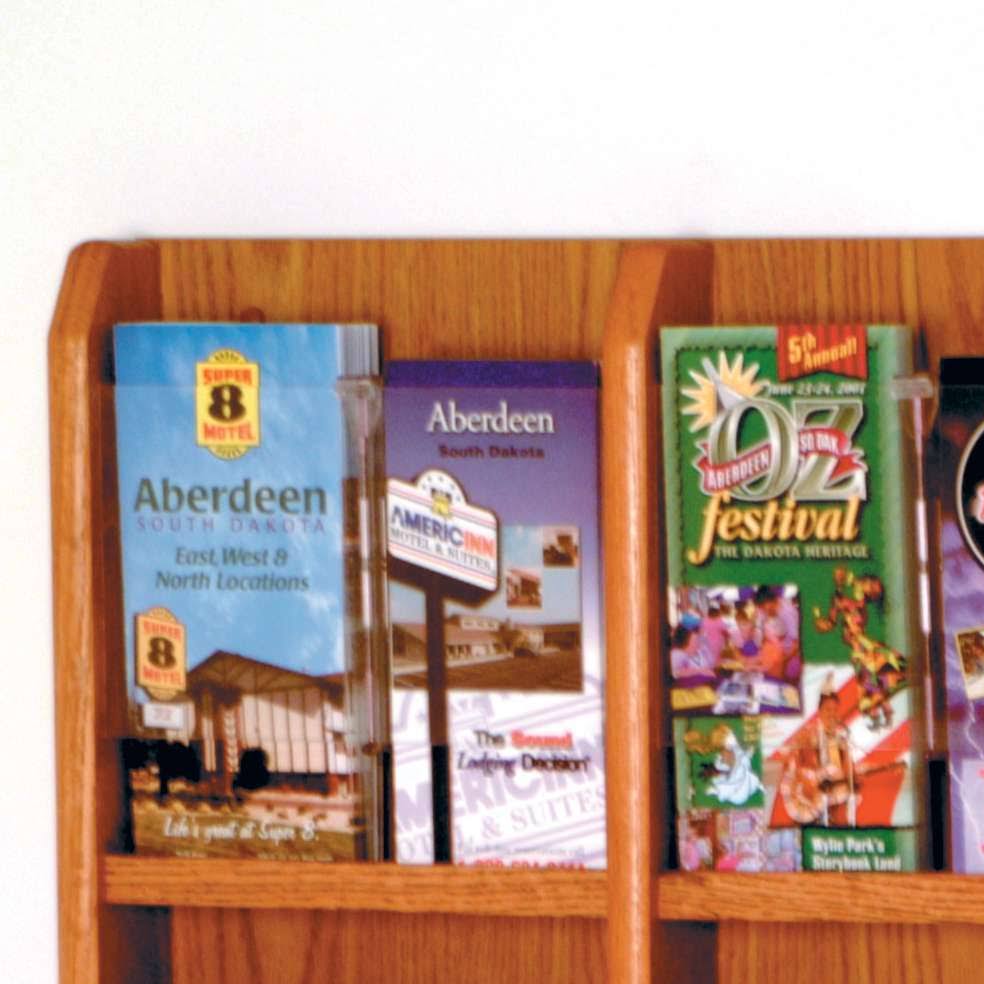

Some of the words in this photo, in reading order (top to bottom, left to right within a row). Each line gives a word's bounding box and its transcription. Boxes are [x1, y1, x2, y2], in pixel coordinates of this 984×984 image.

[788, 332, 816, 364] 5th
[203, 368, 252, 384] SUPER
[208, 384, 246, 423] 8
[426, 400, 555, 433] Aberdeen
[203, 424, 254, 441] MOTEL
[438, 444, 484, 459] South
[489, 445, 545, 459] Dakota
[709, 399, 866, 501] OZ
[707, 451, 770, 490] ABERDEEN
[134, 477, 327, 514] Aberdeen
[137, 518, 215, 532] SOUTH
[231, 518, 325, 533] DAKOTA
[688, 490, 859, 564] festival
[222, 548, 269, 566] West
[273, 551, 288, 566] &
[744, 544, 800, 559] DAKOTA
[806, 544, 869, 559] HERITAGE
[155, 572, 210, 590] North
[216, 572, 309, 591] Locations
[148, 637, 175, 670] 8
[474, 729, 505, 747] The
